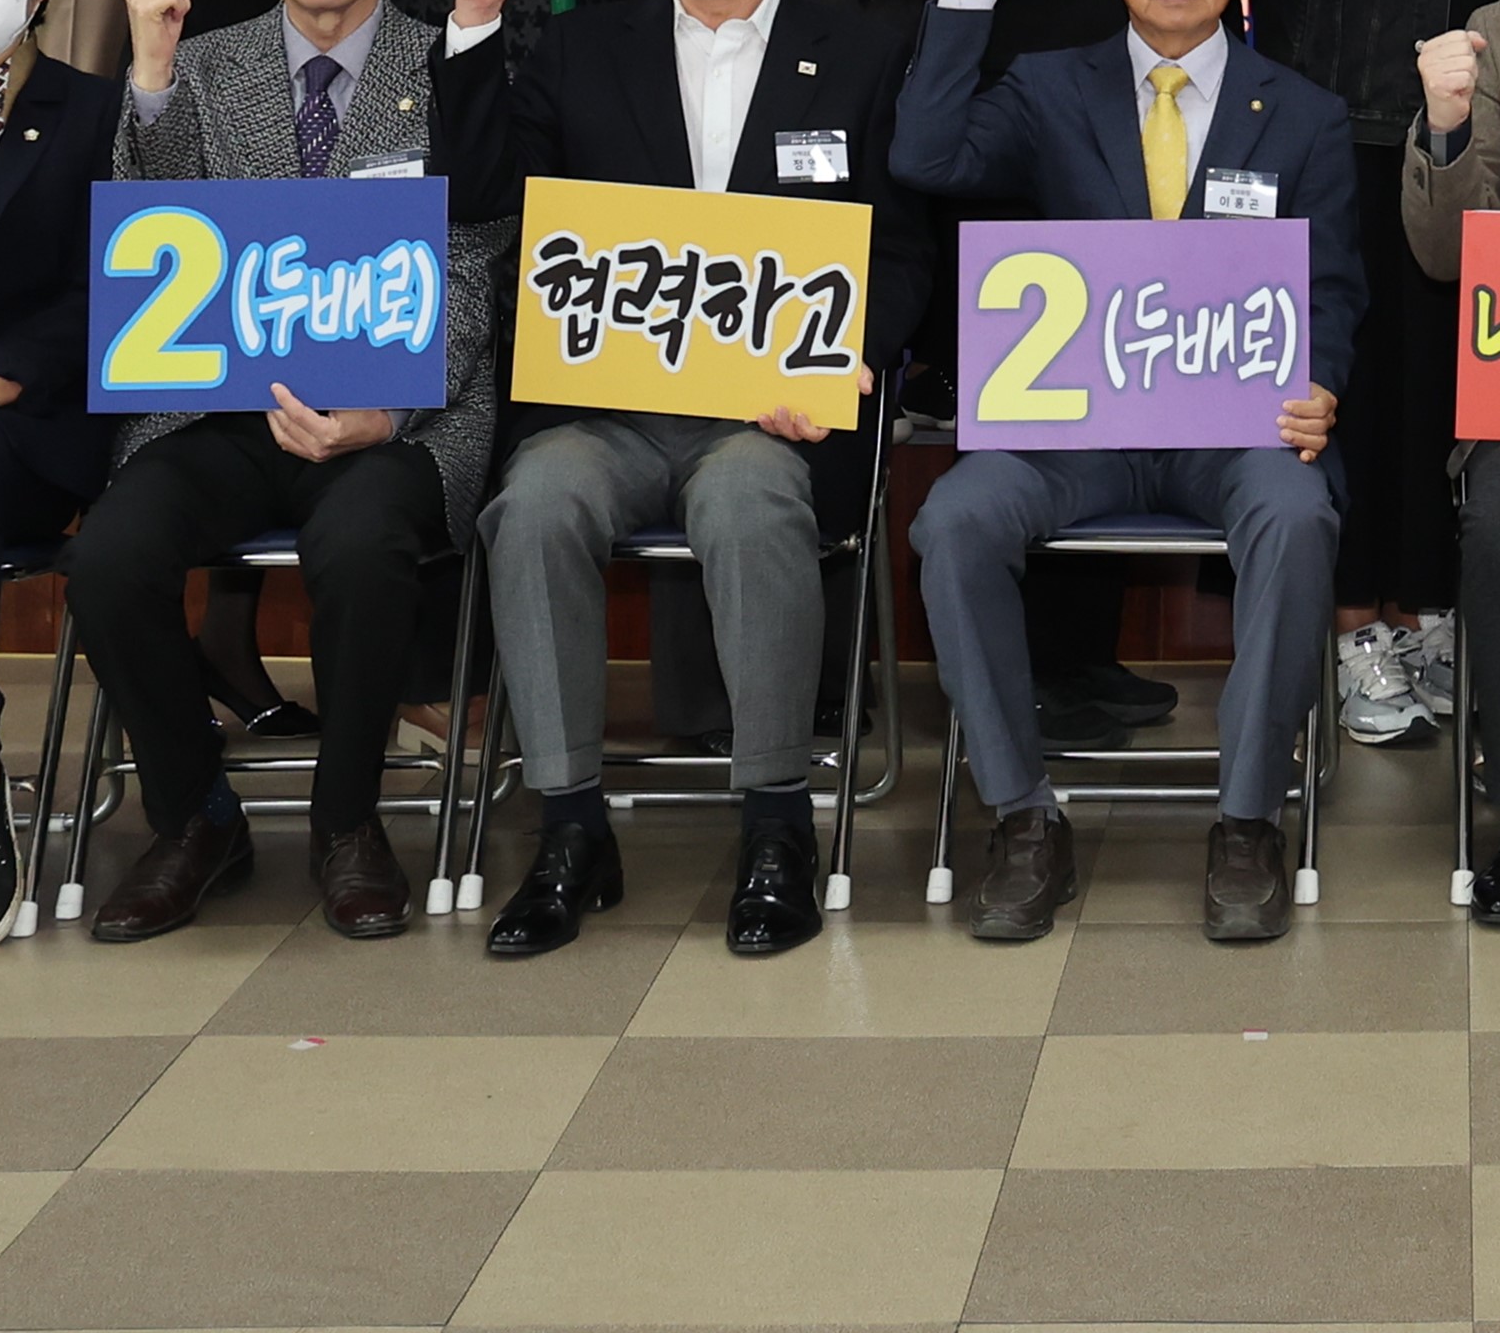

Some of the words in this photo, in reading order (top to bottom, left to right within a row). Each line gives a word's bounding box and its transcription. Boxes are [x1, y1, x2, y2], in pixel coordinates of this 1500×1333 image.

[102, 206, 441, 390] 2(두배로)
[529, 230, 858, 376] 협력하고
[976, 251, 1298, 422] 2(두배로)
